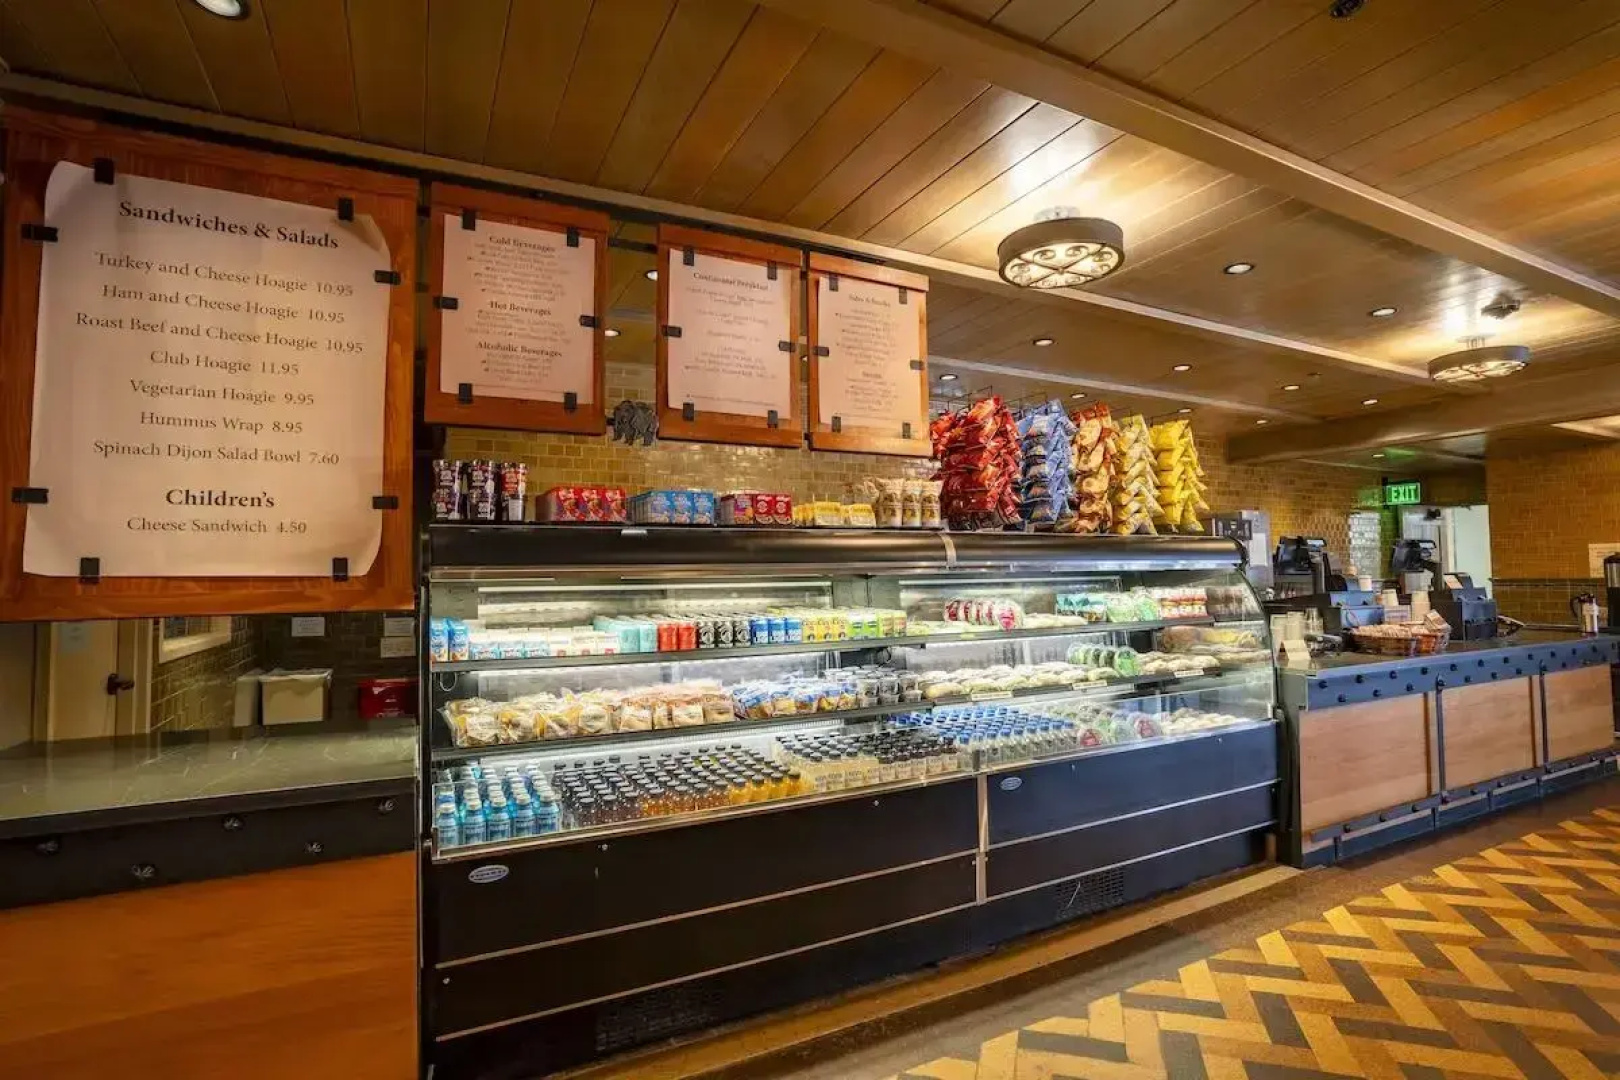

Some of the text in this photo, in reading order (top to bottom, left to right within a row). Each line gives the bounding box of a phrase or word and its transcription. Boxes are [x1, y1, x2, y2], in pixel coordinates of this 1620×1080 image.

[119, 200, 338, 248] Sandwiches & Salads
[95, 252, 353, 296] Turkey and Cheese Hoagie 10.95
[103, 285, 344, 323] Ham and Cheese Hoagie 10.95
[490, 301, 552, 316] Hot Beverages
[77, 313, 363, 354] Roast Beef and Cheese Hoagie 10.95
[476, 341, 563, 358] Alcoholic Beverages
[151, 351, 298, 376] Club Hoagie 11.95
[130, 379, 314, 405] Vegetarian Hoagie 9.95
[141, 412, 302, 435] Hummus Wrap 8.95
[94, 441, 339, 465] Spinach Dijon Salad Bowl 7.60
[166, 489, 274, 507] Children's
[1391, 485, 1417, 502] EXIT
[127, 518, 307, 534] Cheese Sandwich 4.50
